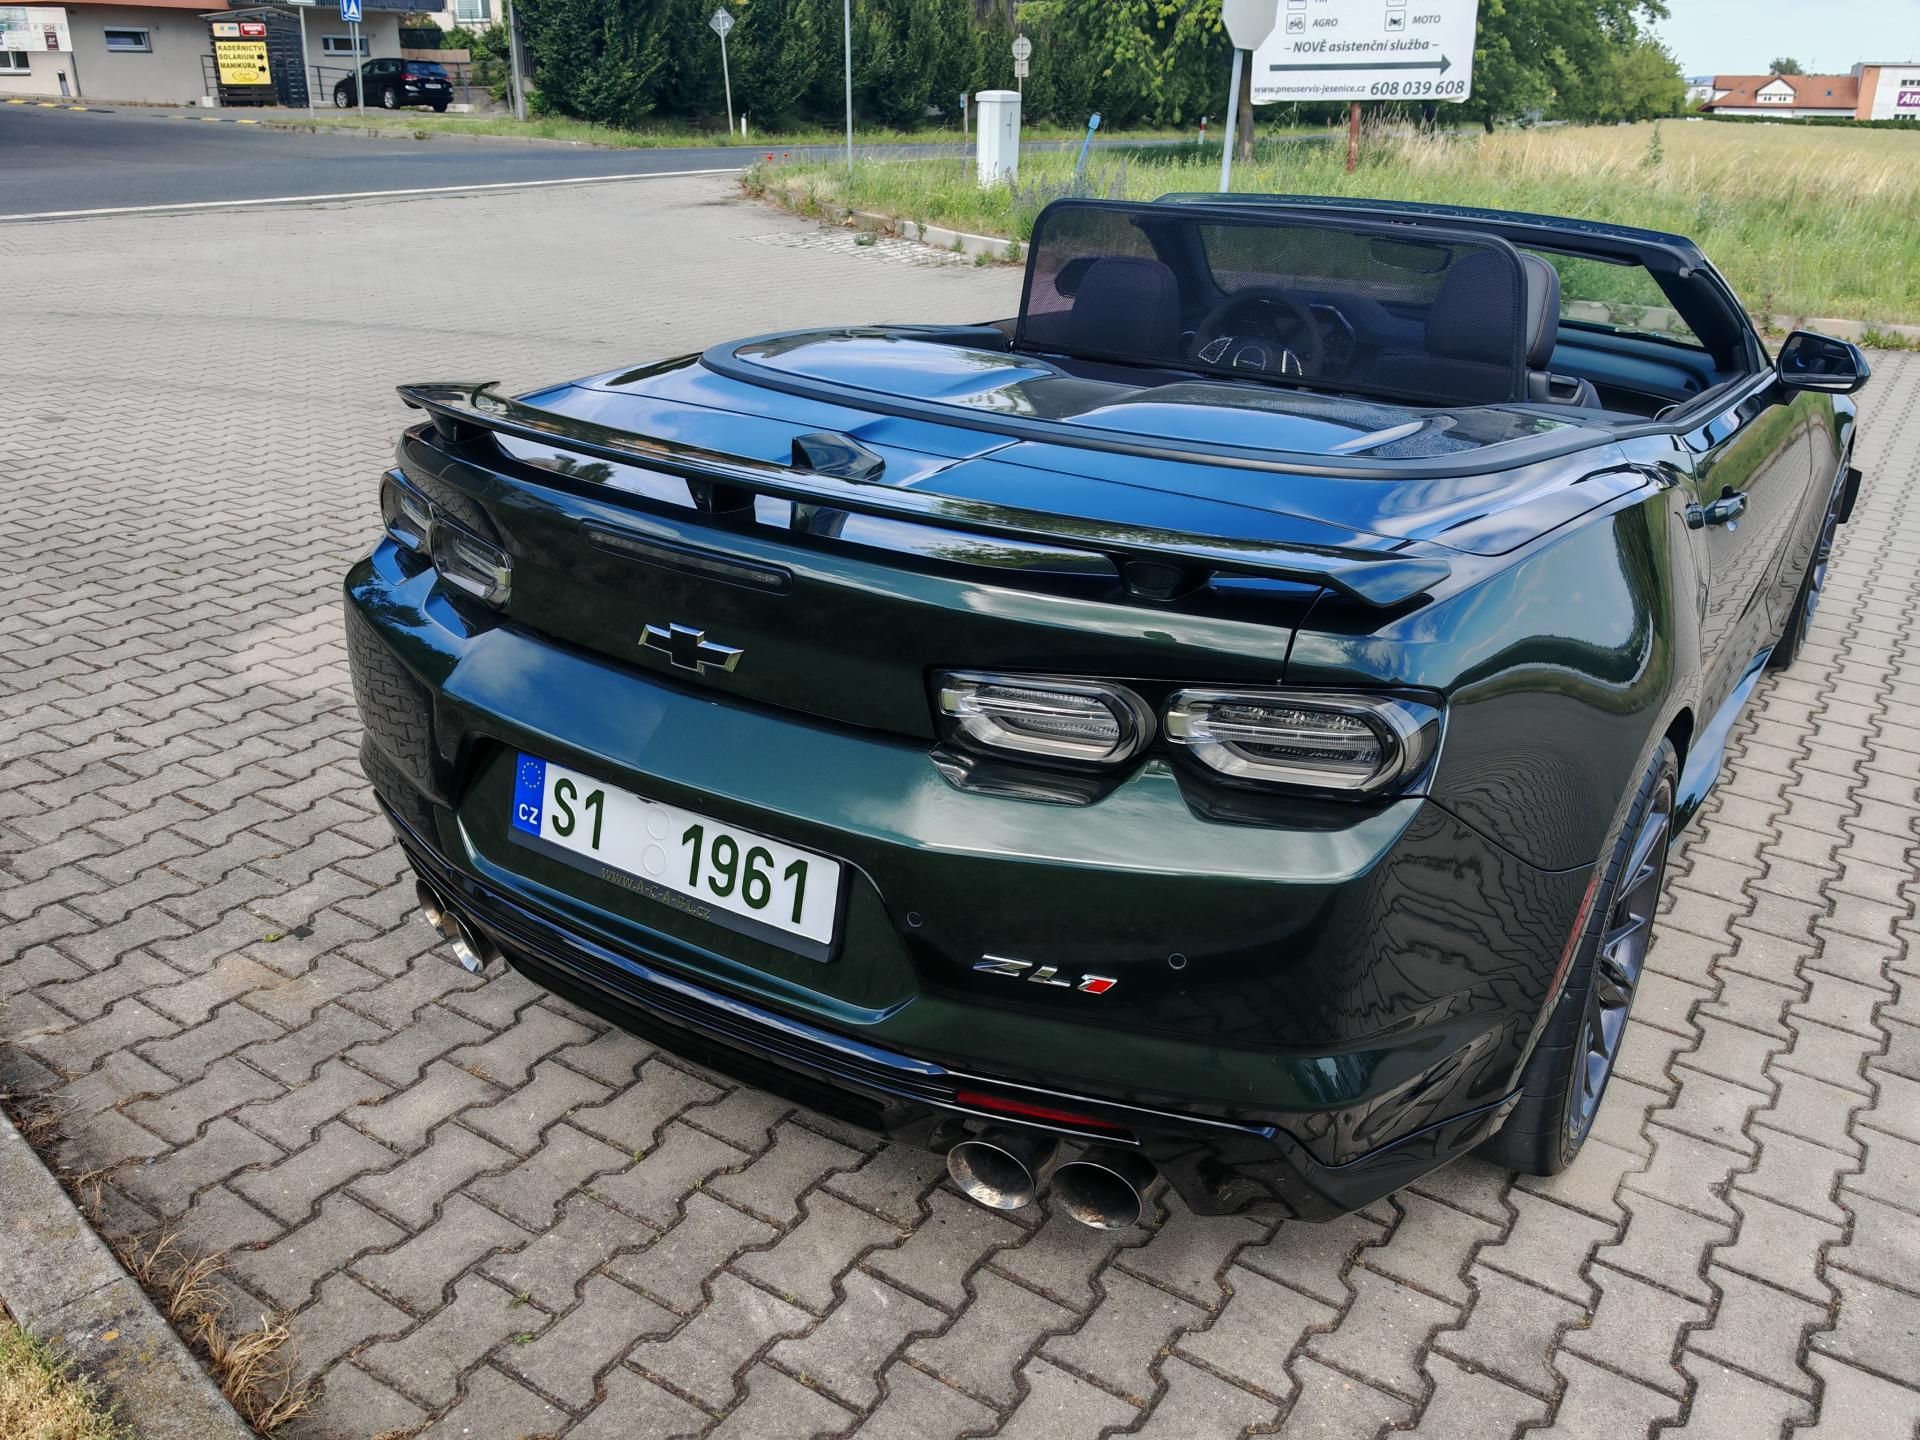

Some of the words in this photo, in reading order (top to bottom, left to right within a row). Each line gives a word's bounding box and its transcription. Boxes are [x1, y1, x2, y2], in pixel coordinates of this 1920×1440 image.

[1312, 18, 1338, 28] AGRO
[1412, 15, 1441, 25] MOTO
[1328, 40, 1389, 52] asistenční
[1389, 38, 1430, 51] služba
[1254, 83, 1366, 95] www.pneuservis-jesenice.cz
[1370, 81, 1400, 96] 608
[1402, 81, 1432, 95] 039
[1435, 80, 1465, 94] 608
[518, 803, 539, 826] CZ
[551, 777, 606, 851] S1
[681, 823, 809, 925] 1961
[972, 953, 1119, 995] ZL1
